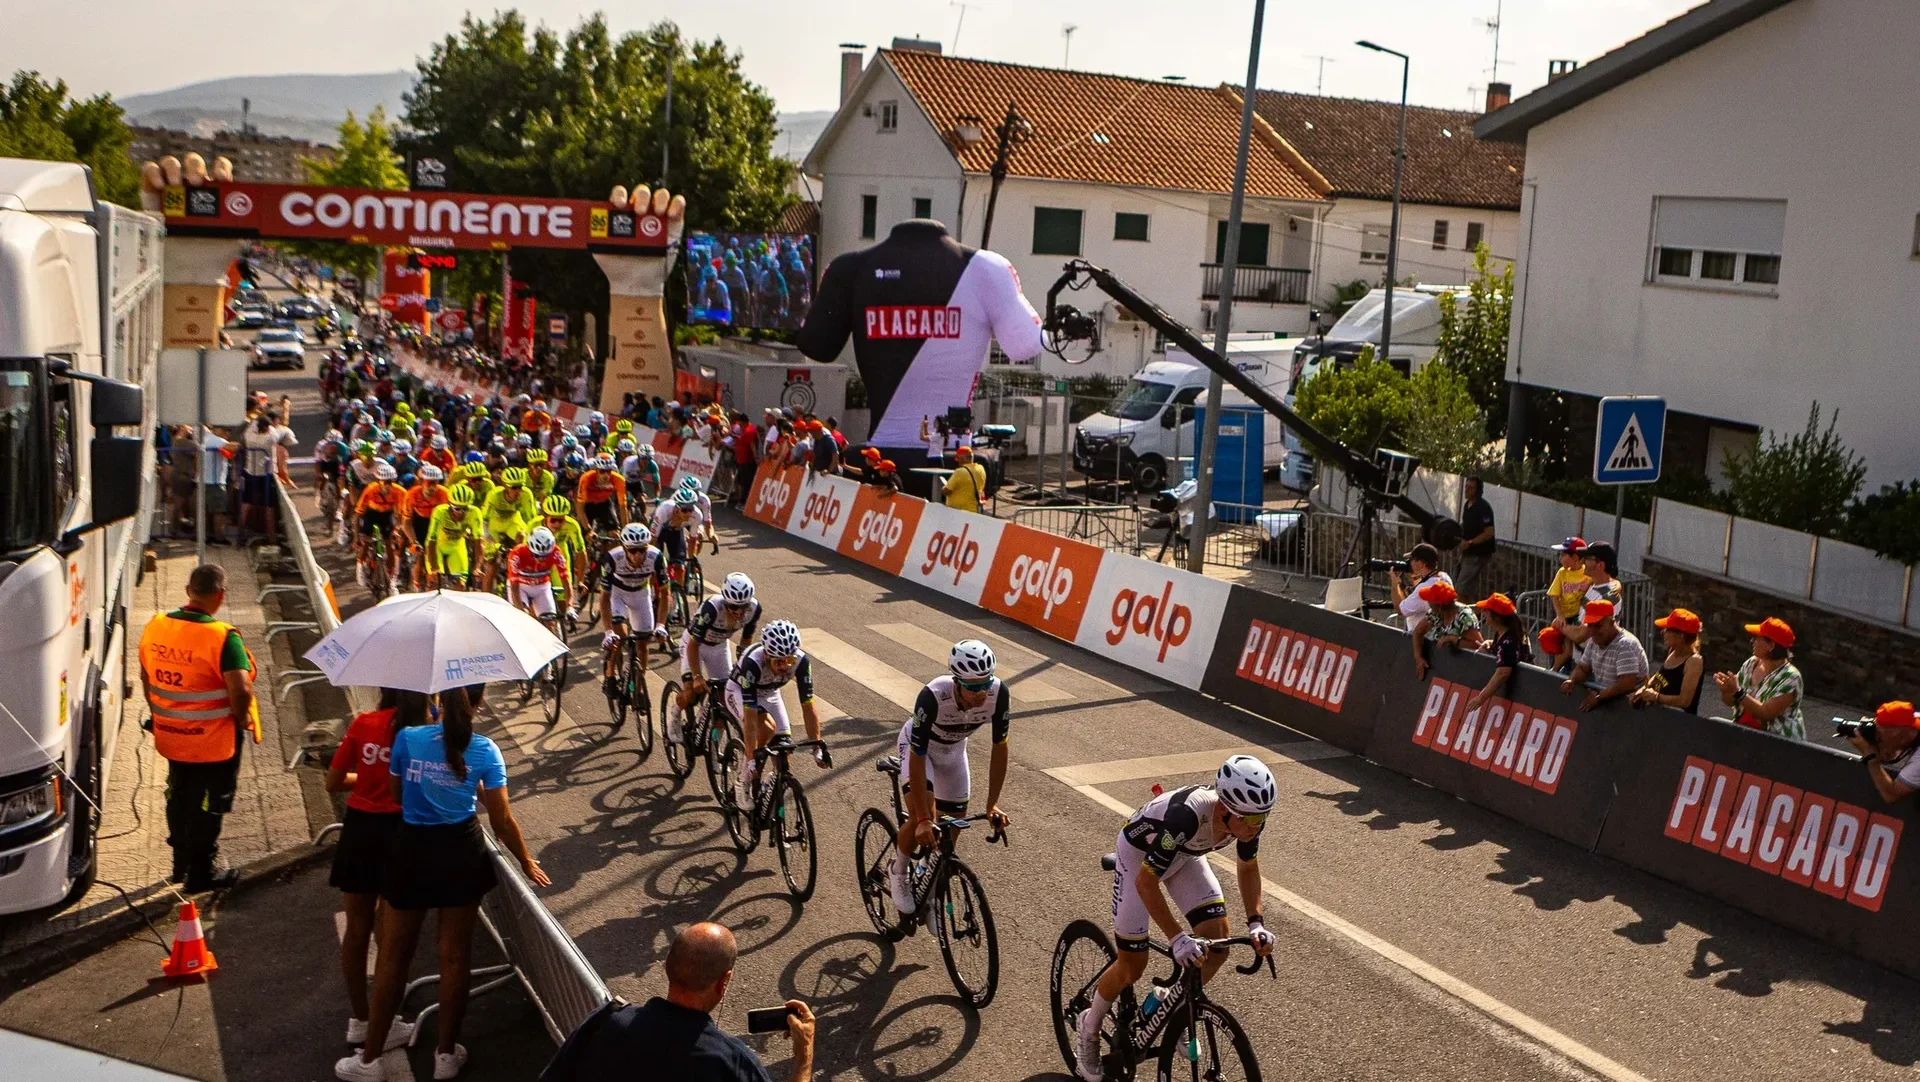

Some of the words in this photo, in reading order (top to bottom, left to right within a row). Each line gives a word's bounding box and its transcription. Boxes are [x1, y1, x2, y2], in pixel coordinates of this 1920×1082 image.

[279, 191, 573, 238] CONTINENTE
[866, 310, 961, 336] PLACARD
[755, 470, 790, 519] galp
[800, 484, 842, 538] galp
[852, 502, 903, 561] galp
[921, 523, 980, 587] galp
[1003, 546, 1074, 621] galp
[1105, 580, 1193, 664] galp
[155, 668, 184, 687] 032
[461, 653, 506, 665] PAREDES
[1240, 624, 1355, 708] PLACARD
[1416, 684, 1571, 785] PLACARD
[1670, 765, 1896, 900] PLACARD
